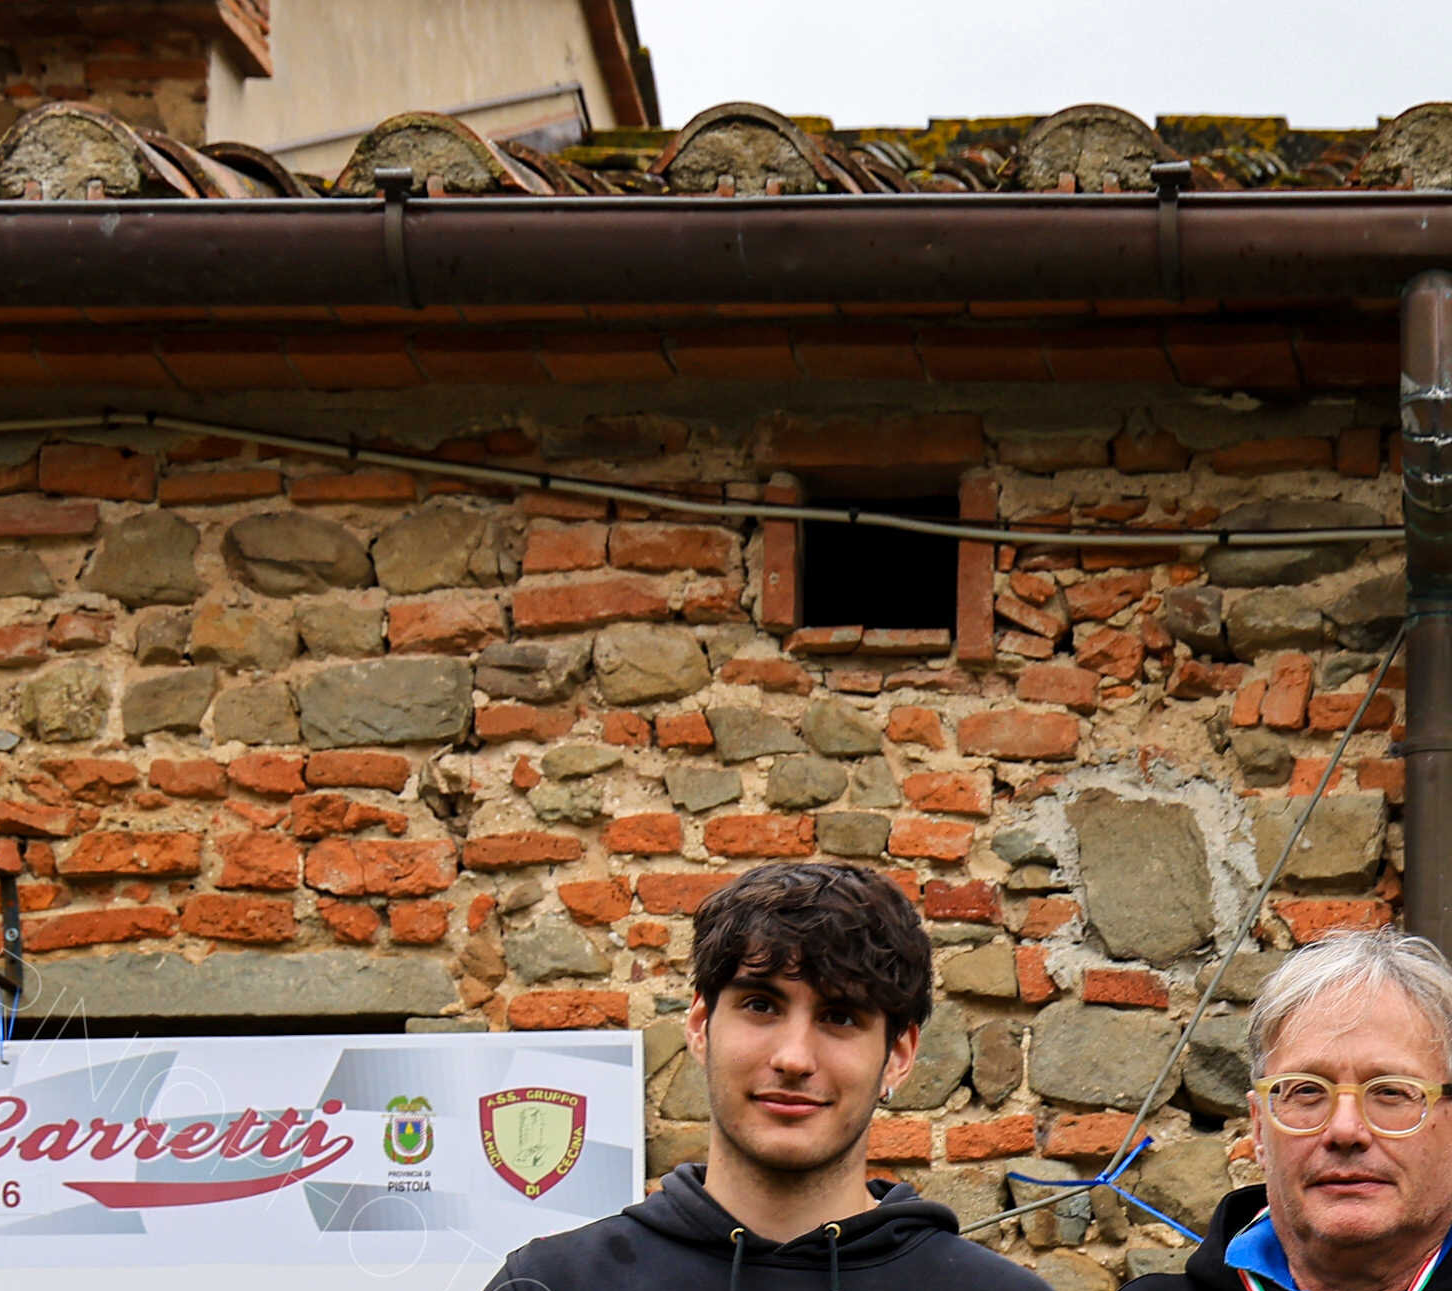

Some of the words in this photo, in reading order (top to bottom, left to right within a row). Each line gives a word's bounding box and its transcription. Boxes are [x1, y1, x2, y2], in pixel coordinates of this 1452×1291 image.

[526, 1090, 578, 1107] GRUPPO
[483, 1129, 502, 1169] AMICI
[557, 1126, 584, 1175] CECINA
[388, 1181, 431, 1192] PISTOIA
